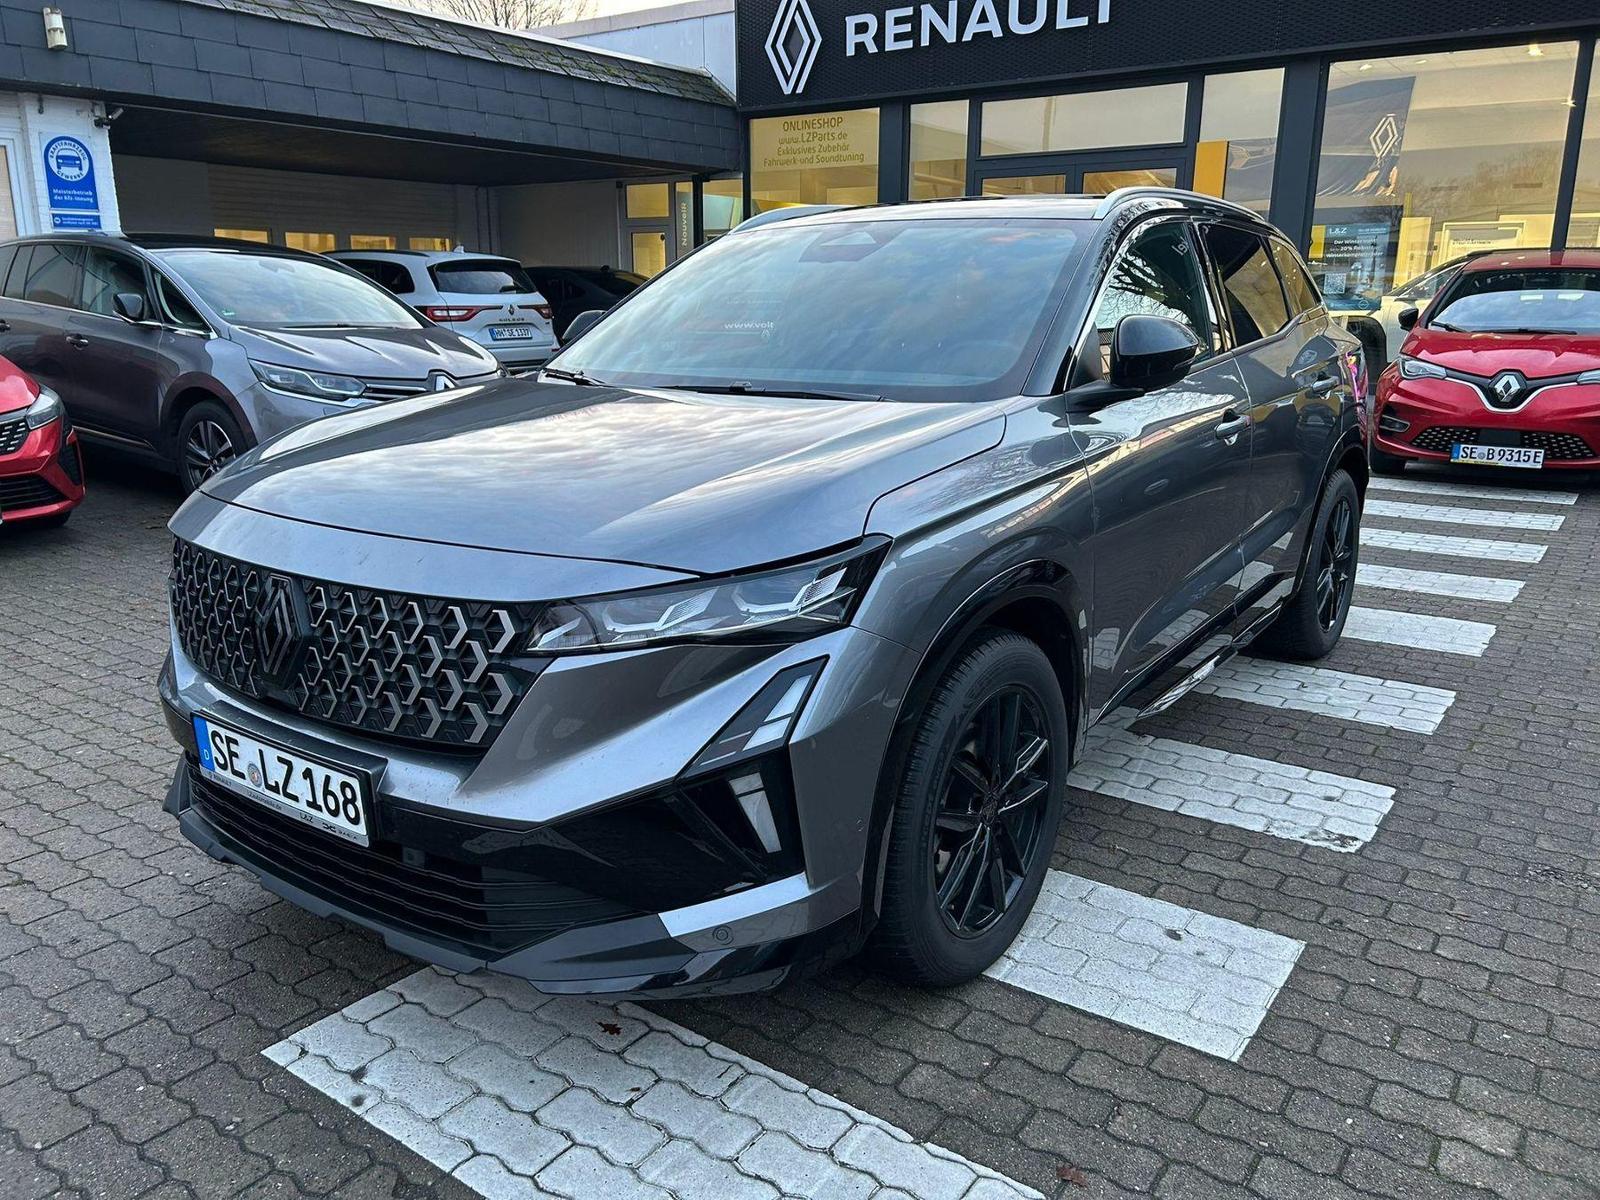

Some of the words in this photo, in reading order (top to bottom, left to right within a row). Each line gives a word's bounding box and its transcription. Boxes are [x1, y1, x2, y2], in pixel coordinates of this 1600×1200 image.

[782, 116, 844, 132] ONLINESHOP
[778, 131, 848, 145] www.LZParts.de
[777, 145, 816, 156] Exklusives
[818, 142, 850, 153] Zubehör
[799, 155, 814, 165] und
[815, 153, 865, 163] Soundtuning
[1460, 446, 1478, 460] SE
[1486, 447, 1495, 461] B
[210, 730, 246, 780] SE
[259, 749, 300, 803] LZ
[302, 767, 361, 826] 168
